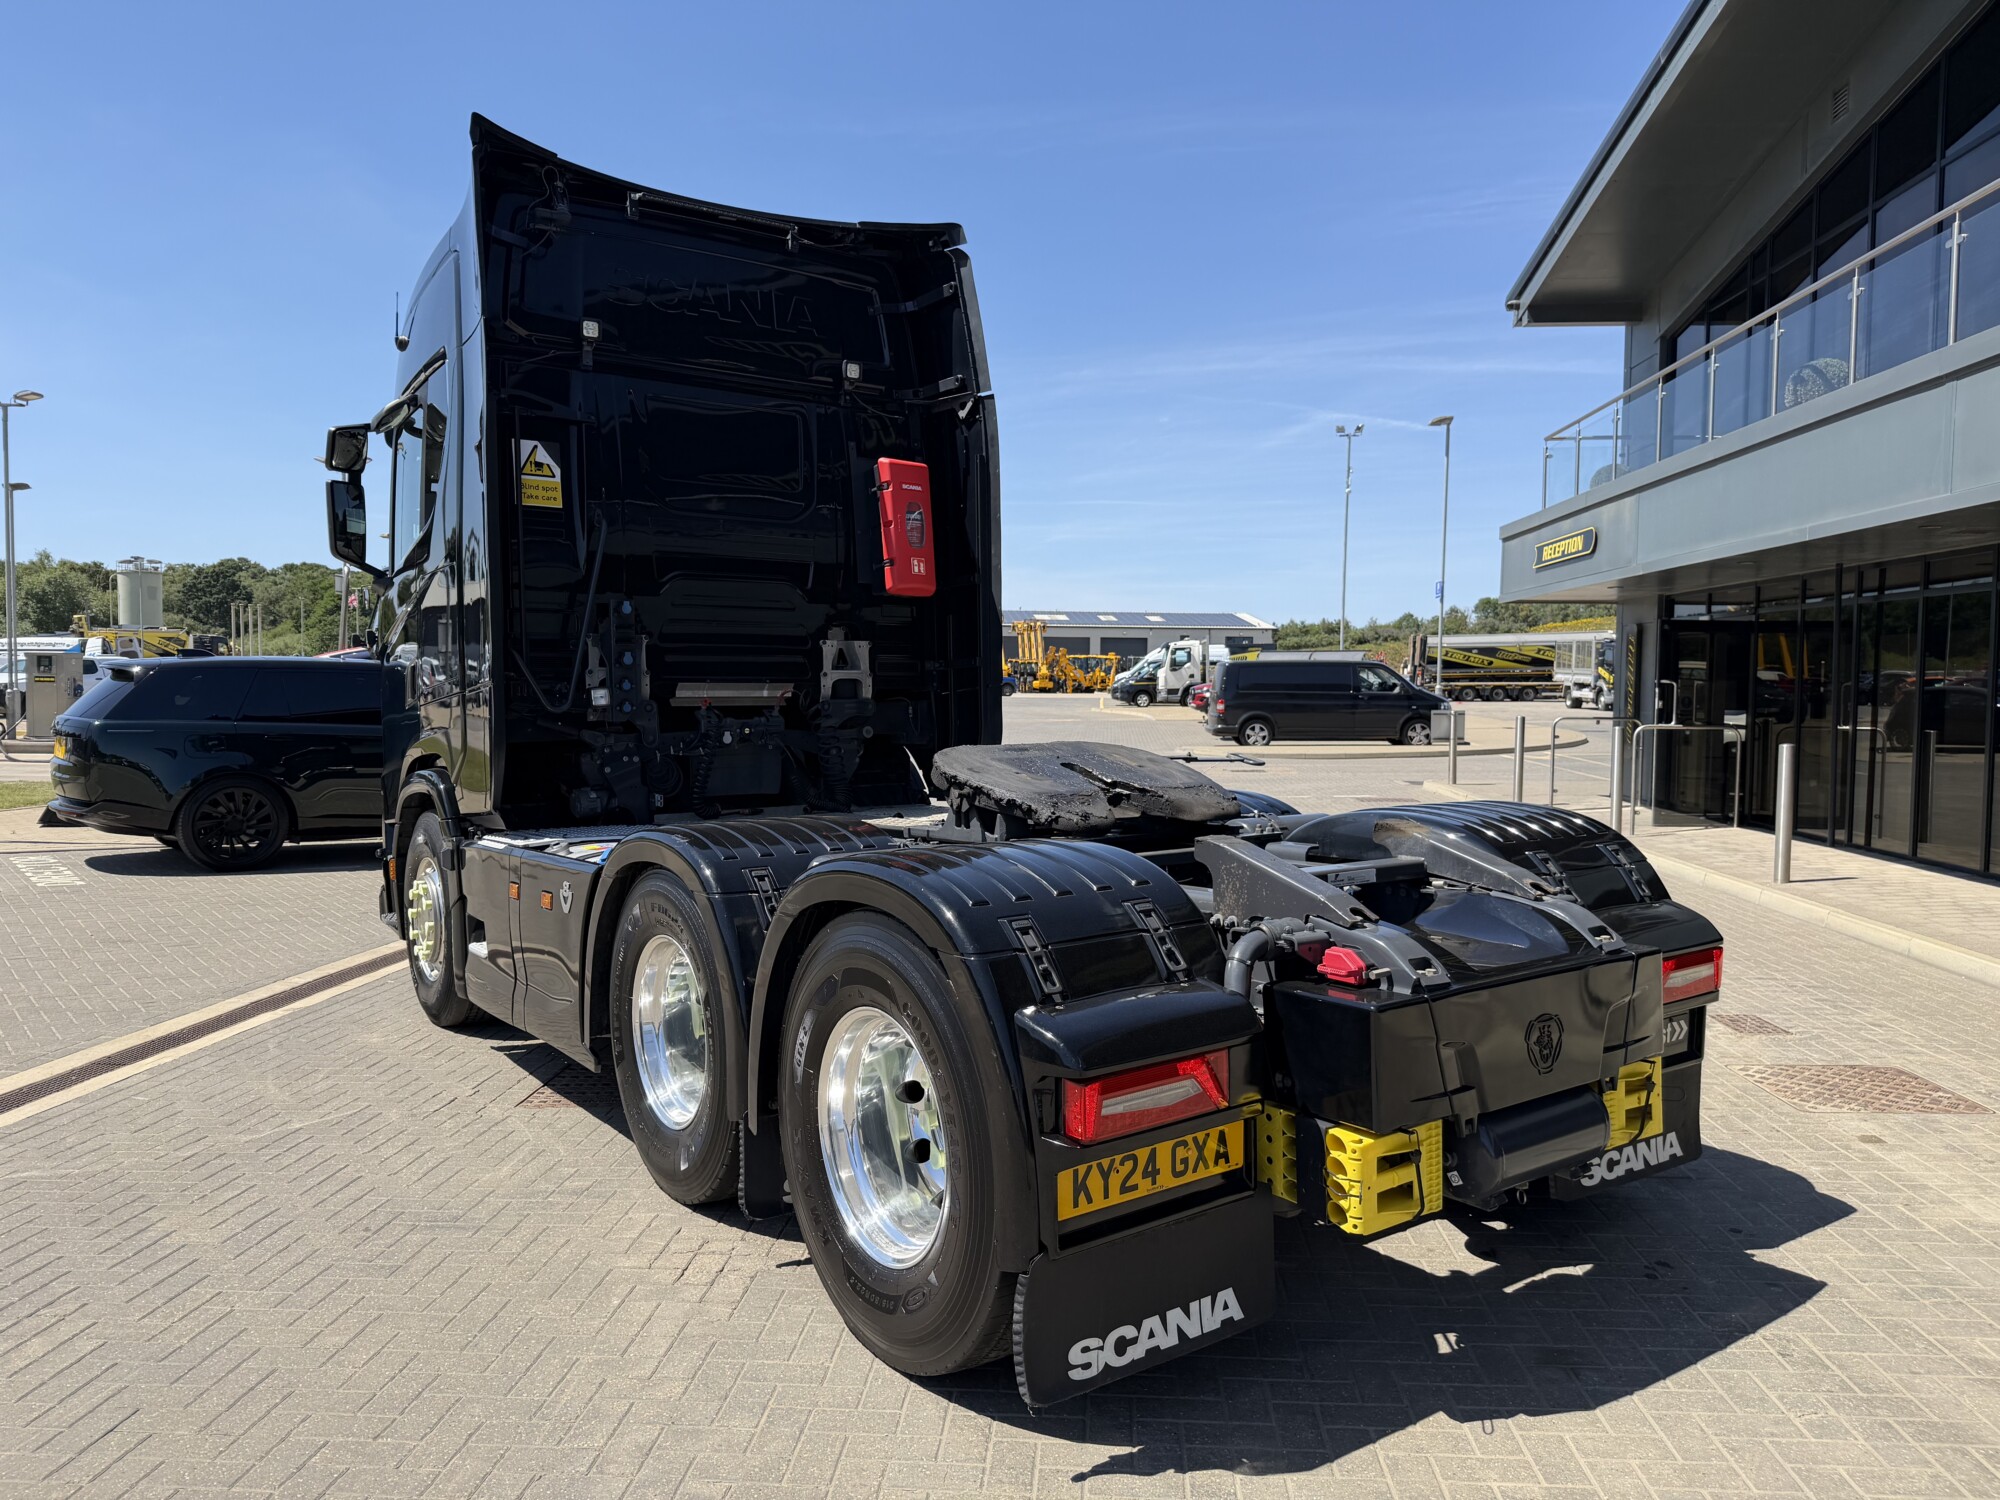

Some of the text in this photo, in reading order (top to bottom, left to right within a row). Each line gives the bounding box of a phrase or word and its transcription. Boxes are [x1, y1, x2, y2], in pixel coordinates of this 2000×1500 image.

[607, 267, 818, 336] SCANIA
[522, 492, 539, 500] Take
[542, 485, 558, 493] spot
[902, 483, 922, 491] SCANIA
[1542, 534, 1584, 561] RECEPTION
[1072, 1128, 1231, 1209] KY24 GXA
[1580, 1131, 1683, 1187] SCANIA
[1067, 1287, 1245, 1381] SCANIA
